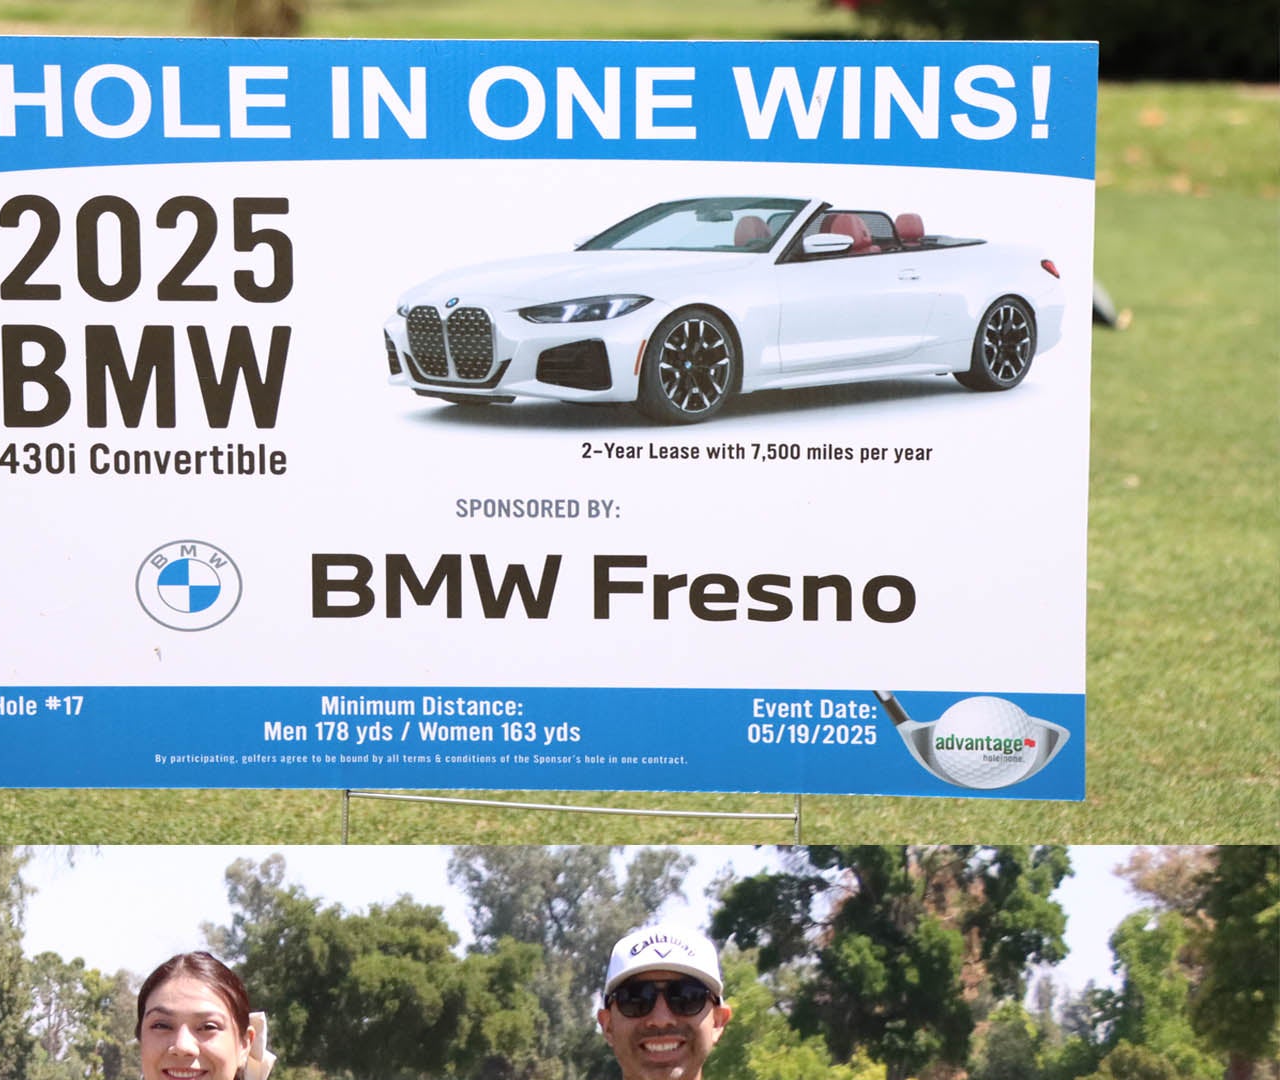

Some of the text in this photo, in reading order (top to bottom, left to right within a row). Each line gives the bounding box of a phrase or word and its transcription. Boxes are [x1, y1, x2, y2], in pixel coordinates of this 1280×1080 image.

[331, 66, 427, 140] IN
[468, 66, 697, 141] ONE
[732, 65, 1052, 141] WINS!
[1, 324, 292, 429] BMW
[89, 442, 287, 476] Convertible
[581, 442, 933, 464] 2-Year Lease with 7,500 miles per year
[455, 498, 621, 519] SPONSORED BY:
[150, 544, 228, 570] BMW
[311, 553, 917, 624] BMW Fresno
[44, 695, 84, 716] #17
[321, 695, 523, 717] Minimum Distance:
[753, 697, 877, 720] Event Date:
[264, 721, 581, 746] Men 178 yds / Women 163 yds
[747, 723, 877, 745] 05/19/2025
[935, 733, 1023, 755] advantage
[154, 753, 688, 766] By participating, golfers agree to be bound by all terms & conditions of the Sponsor's hole in one contract.
